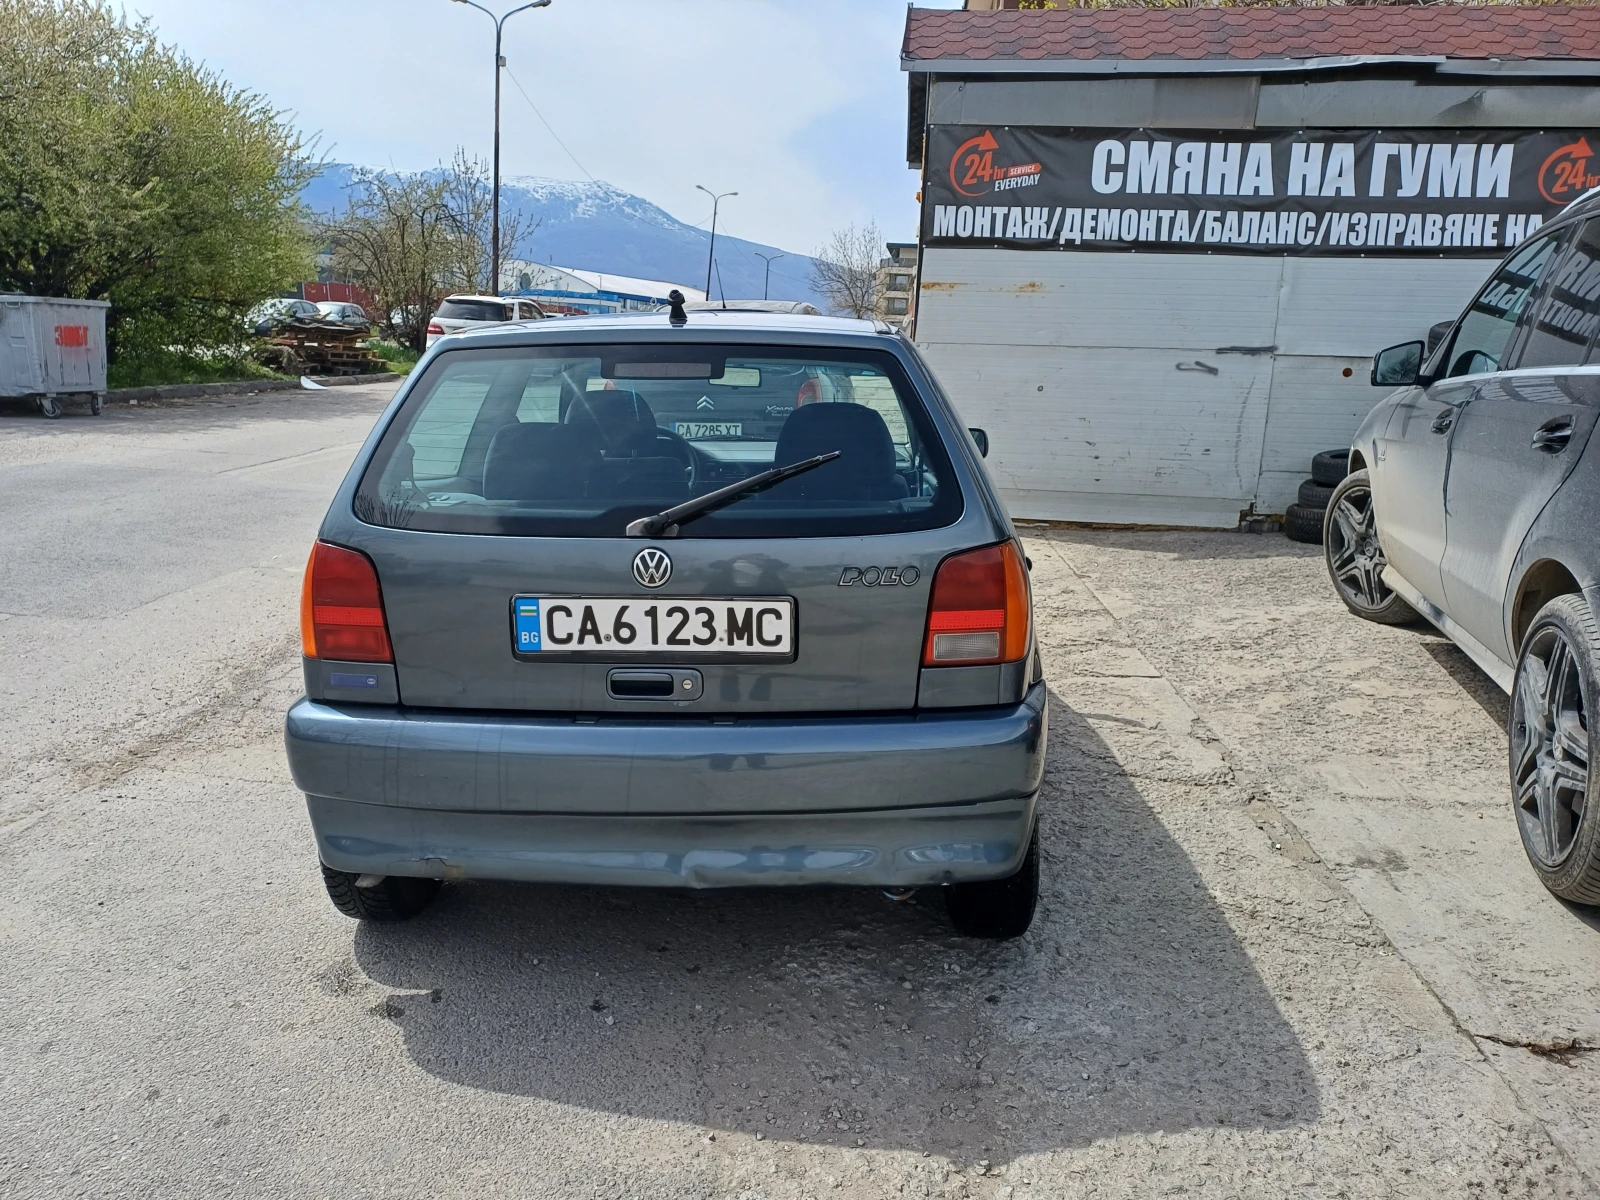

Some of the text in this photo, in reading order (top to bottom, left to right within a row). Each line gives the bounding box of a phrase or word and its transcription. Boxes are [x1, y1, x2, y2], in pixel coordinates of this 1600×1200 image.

[1010, 164, 1036, 176] SERVICE
[1091, 140, 1515, 198] СМЯНА НА ГУМИ
[994, 174, 1040, 192] EVERYDAY
[677, 424, 740, 438] CA 7285 XT
[837, 565, 921, 587] POLO
[546, 604, 783, 647] CA 6123 MC
[521, 631, 539, 644] BG
